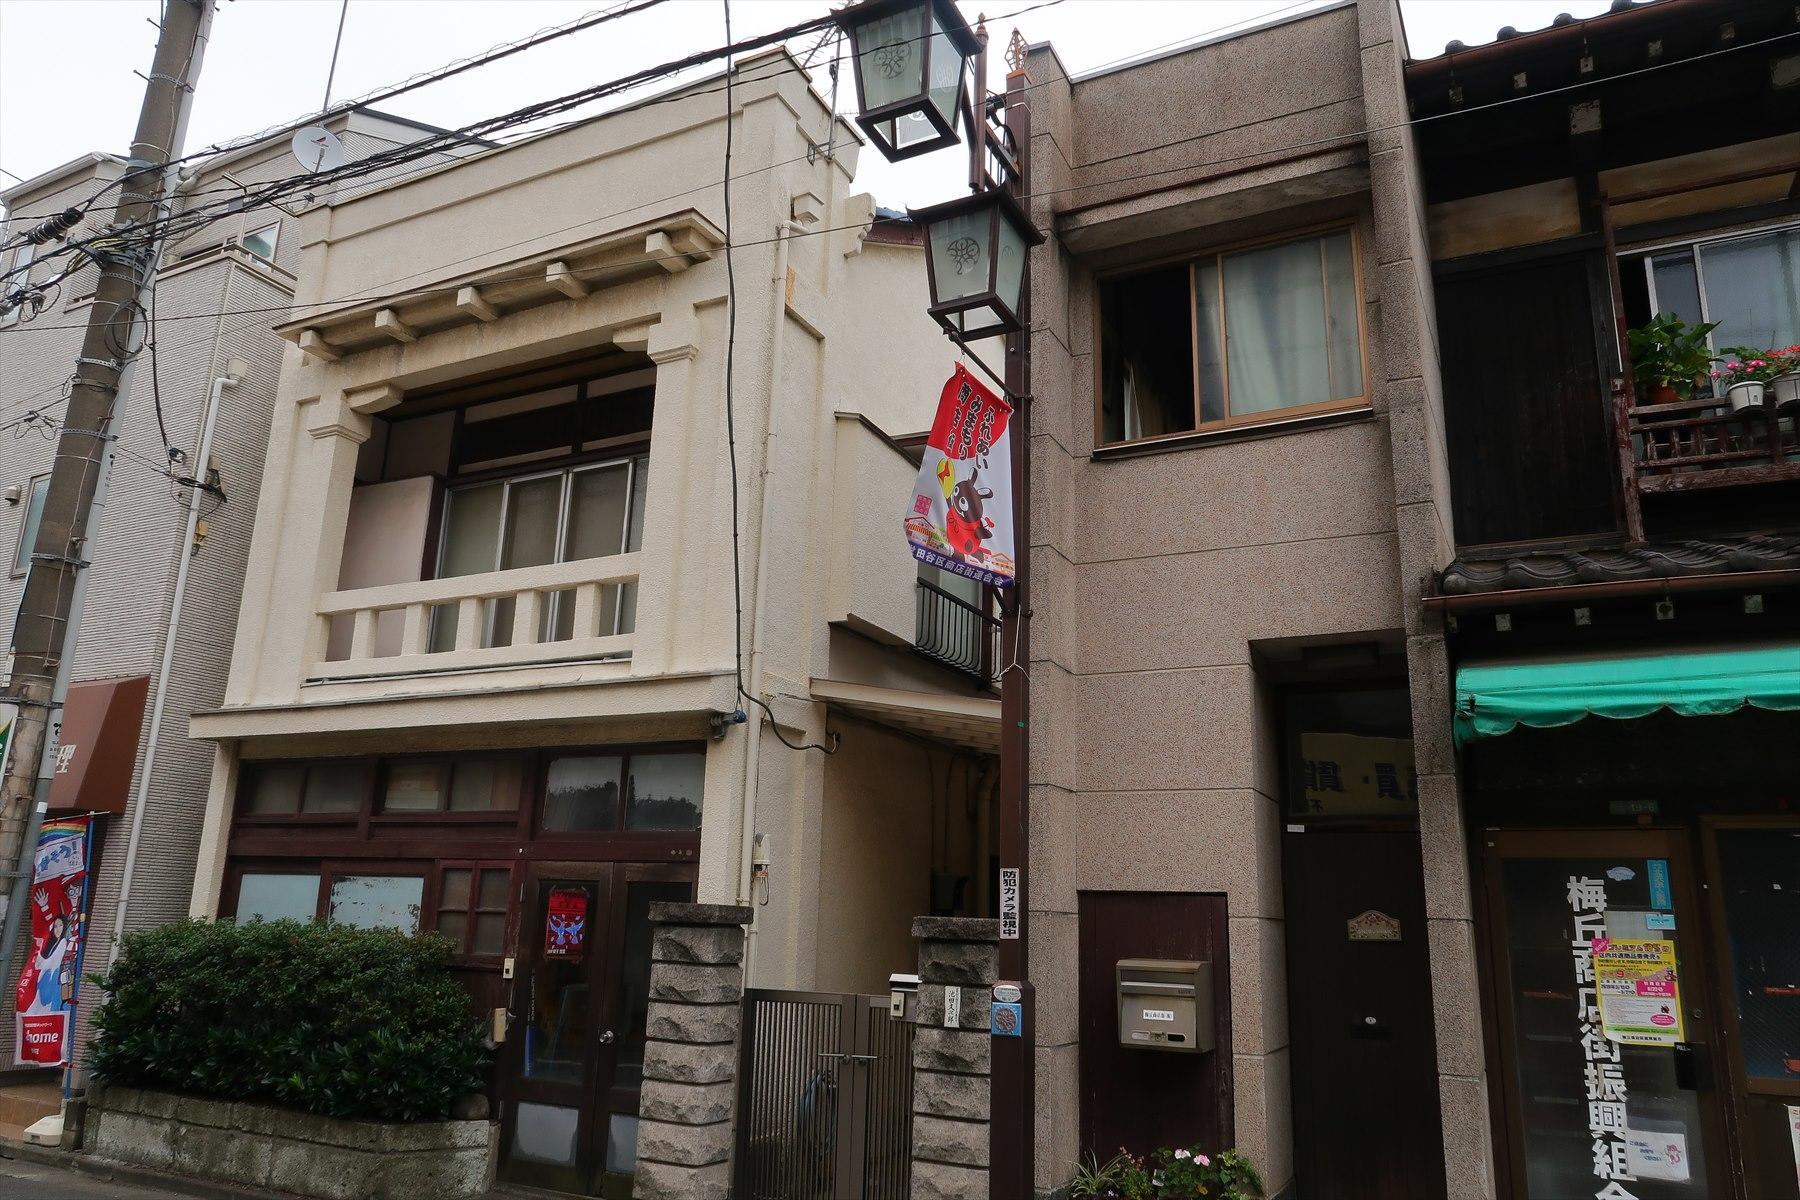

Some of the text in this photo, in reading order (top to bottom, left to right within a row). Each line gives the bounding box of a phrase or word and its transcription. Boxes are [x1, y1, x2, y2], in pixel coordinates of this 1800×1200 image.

[974, 405, 996, 470] ふれあい
[1002, 870, 1017, 937] 防犯カメラ監視中
[25, 1030, 59, 1044] home
